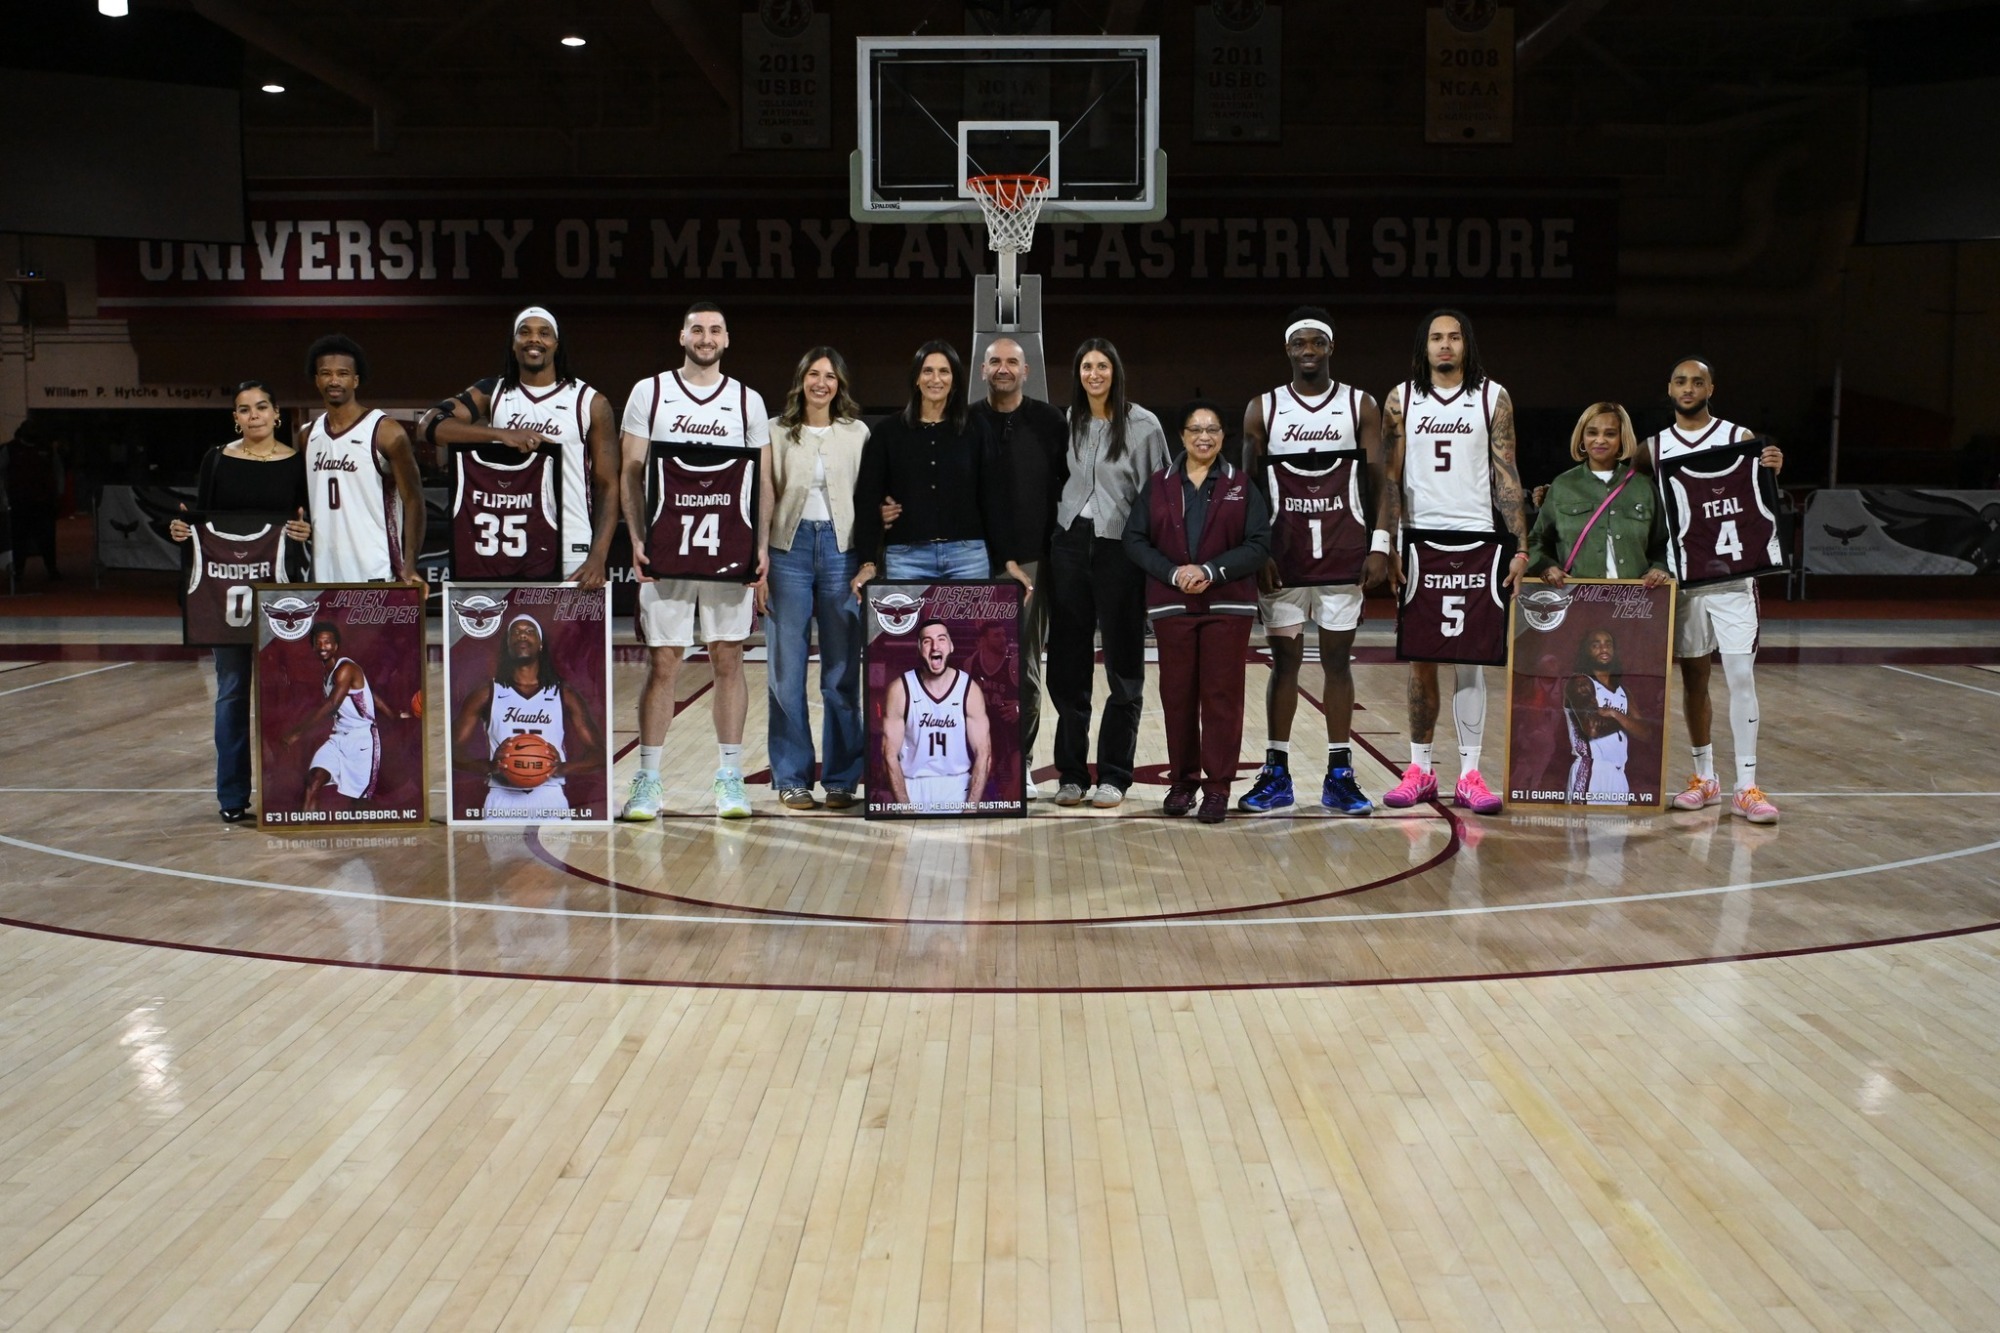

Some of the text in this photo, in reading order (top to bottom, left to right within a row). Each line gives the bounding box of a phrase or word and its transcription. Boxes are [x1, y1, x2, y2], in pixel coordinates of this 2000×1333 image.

[759, 54, 816, 73] 2013
[1212, 47, 1264, 65] 2011
[1440, 48, 1499, 68] 2008
[758, 79, 817, 96] USBC
[1208, 71, 1267, 88] USBC
[1440, 80, 1499, 97] NCAA
[871, 202, 901, 210] SPALDING
[138, 217, 1575, 281] UNIVERSITY OF MARYLAN EASTERN SHORE
[45, 387, 88, 398] William
[115, 387, 159, 400] Hytche
[167, 387, 213, 400] Legacy
[504, 413, 563, 437] Hawks
[669, 414, 729, 437] Hawks
[1281, 424, 1342, 442] Hawks
[1414, 416, 1474, 435] Hawks
[313, 451, 358, 472] Hawks
[1434, 440, 1452, 472] 5
[328, 477, 341, 510] 0
[472, 490, 533, 510] FLIPPIN
[674, 493, 731, 508] LOCANDRO
[1284, 495, 1344, 514] OBANLA
[1702, 497, 1744, 519] TEAL
[474, 512, 528, 558] 35
[678, 513, 721, 556] 14
[1308, 519, 1323, 559] 1
[1715, 519, 1744, 561] 4
[207, 561, 271, 580] COOPER
[1424, 572, 1487, 591] STAPLES
[326, 590, 389, 608] JADEN
[513, 588, 605, 605] CHRISTOPHER
[925, 586, 995, 603] JOSEPH
[1574, 584, 1649, 602] MICHAEL
[225, 585, 254, 628] 0
[346, 606, 420, 624] COOPER
[553, 603, 606, 621] FLIPPIN
[928, 602, 1019, 620] LOCANDRO
[1612, 601, 1654, 618] TEAL
[1440, 595, 1466, 638] 5
[503, 707, 552, 724] Hawks
[919, 712, 957, 728] Hawks
[928, 731, 947, 757] 14
[1531, 791, 1565, 800] GUARD
[1639, 793, 1653, 802] VA
[580, 808, 592, 817] LA
[887, 802, 924, 811] FORWARD
[979, 801, 1021, 809] AUSTRALIA
[290, 811, 326, 822] GUARD
[403, 809, 417, 819] NC
